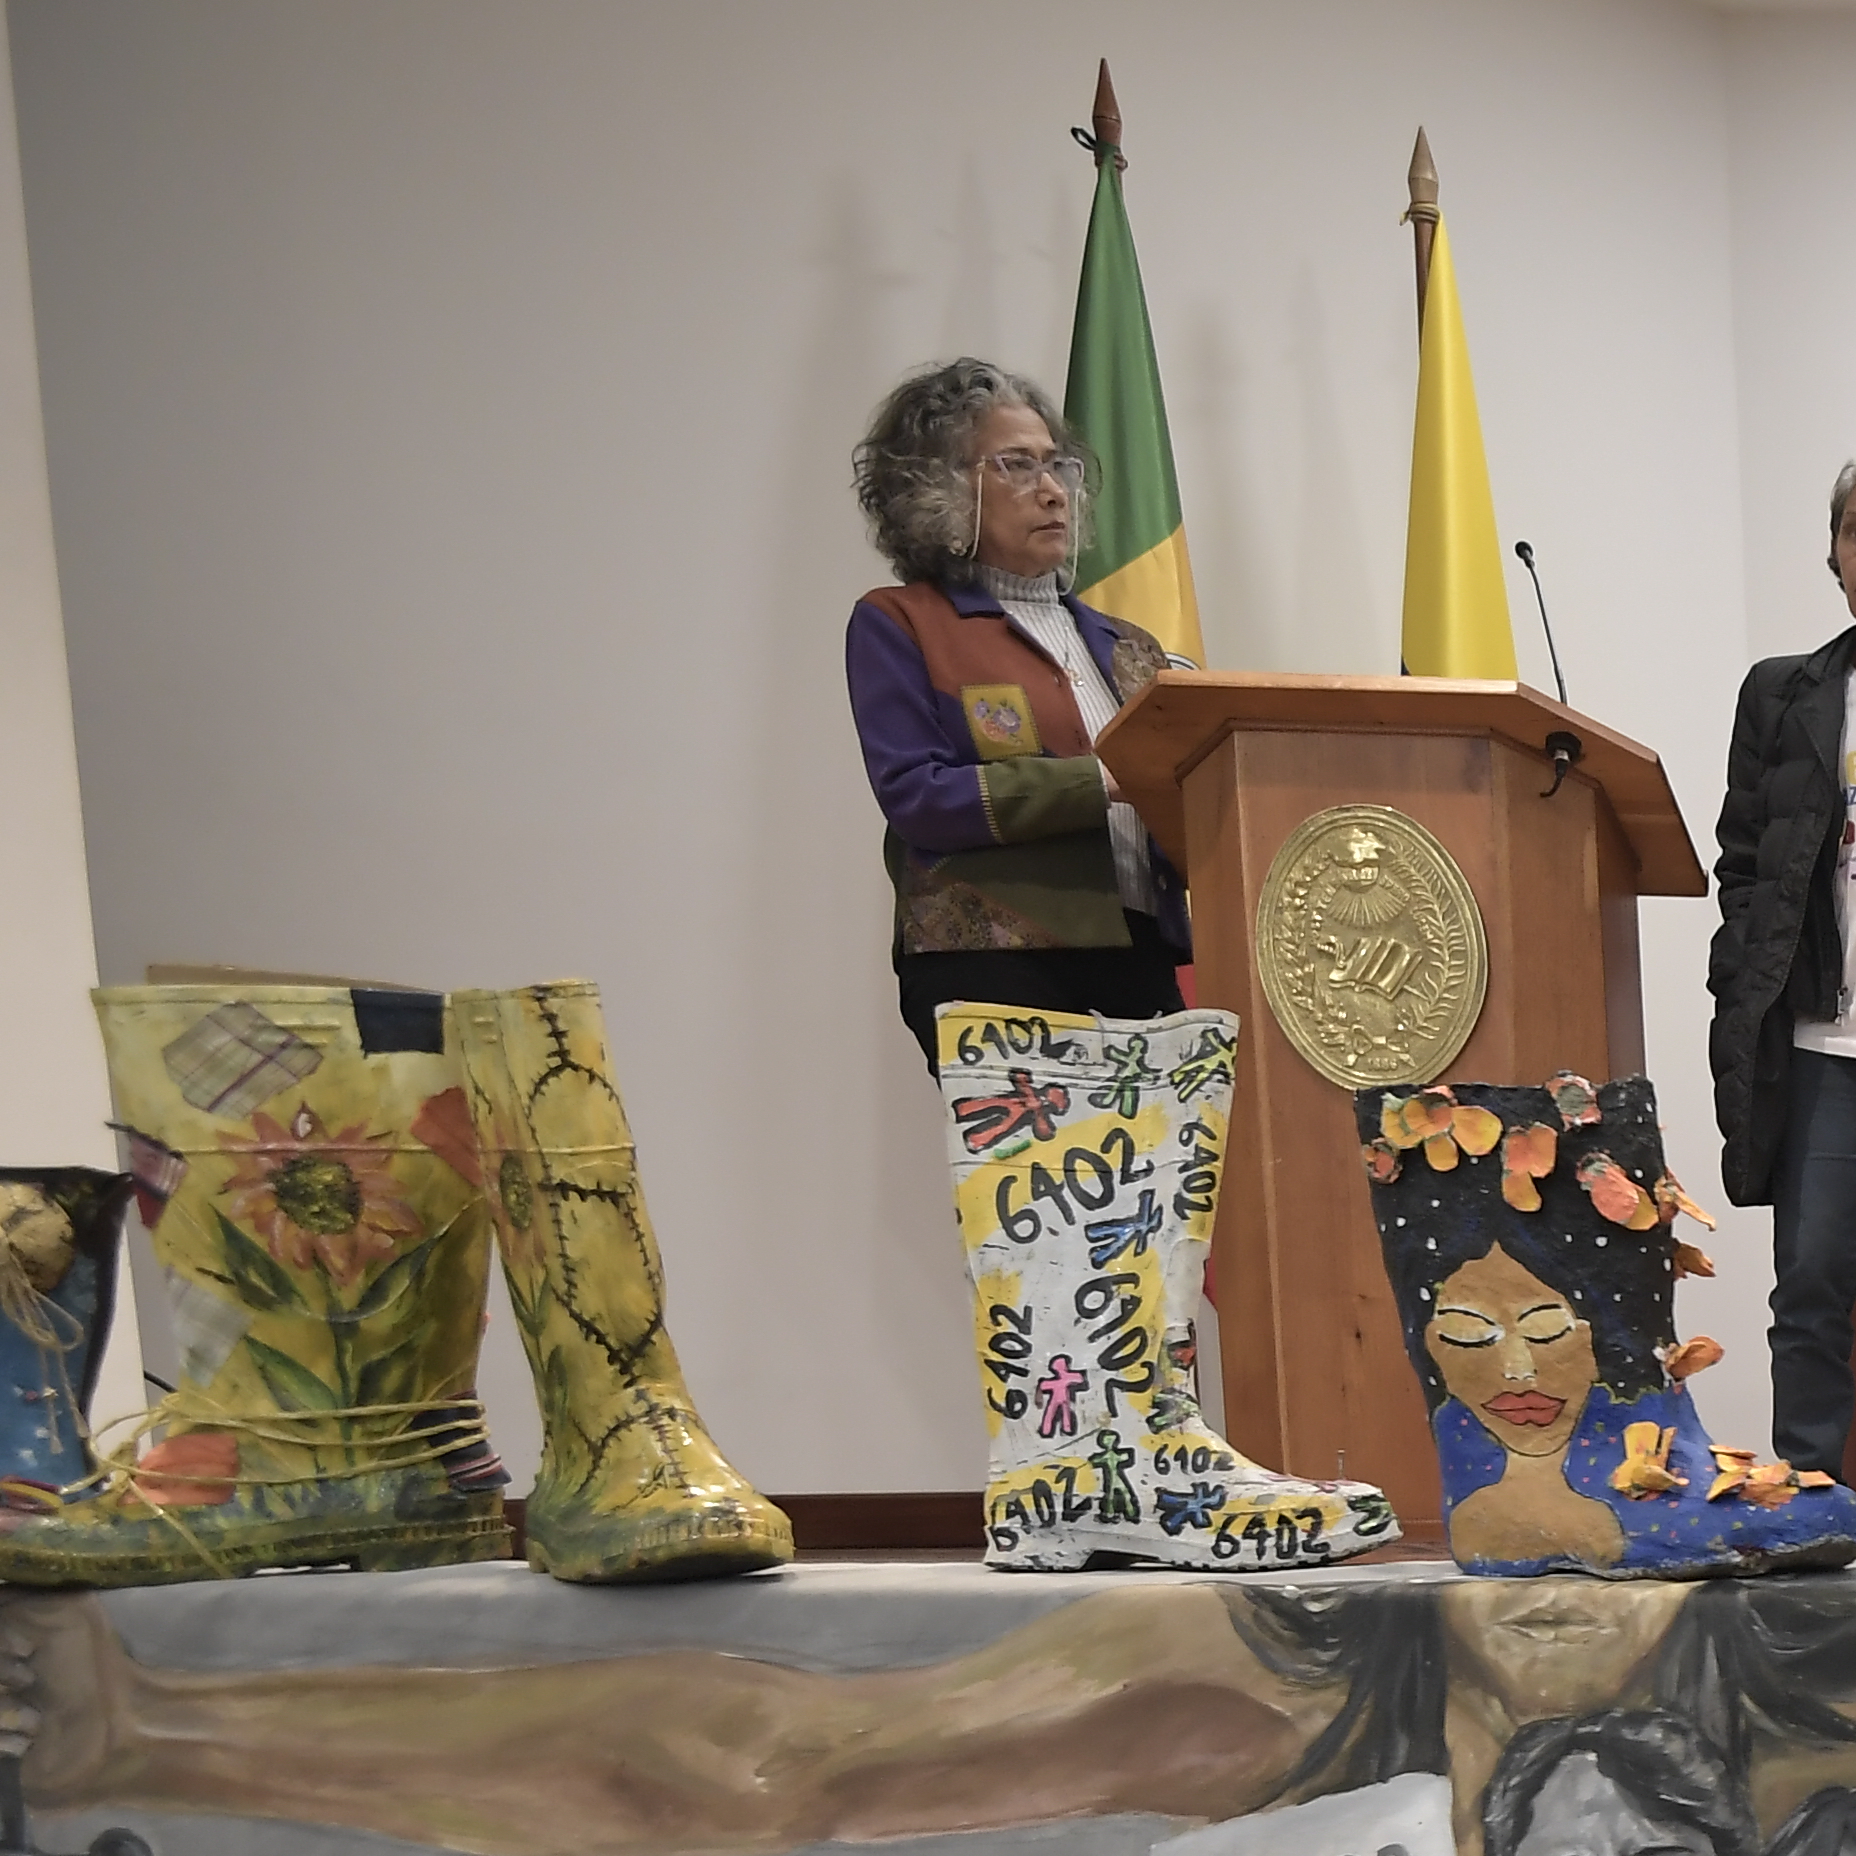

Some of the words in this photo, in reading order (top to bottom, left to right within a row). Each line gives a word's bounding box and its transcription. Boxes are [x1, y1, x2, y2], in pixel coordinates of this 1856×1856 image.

[957, 1015, 1075, 1066] 6402
[995, 1127, 1156, 1244] 6402
[1173, 1116, 1221, 1221] 6402
[1073, 1272, 1156, 1419] 6402
[1211, 1506, 1332, 1560] 6402
